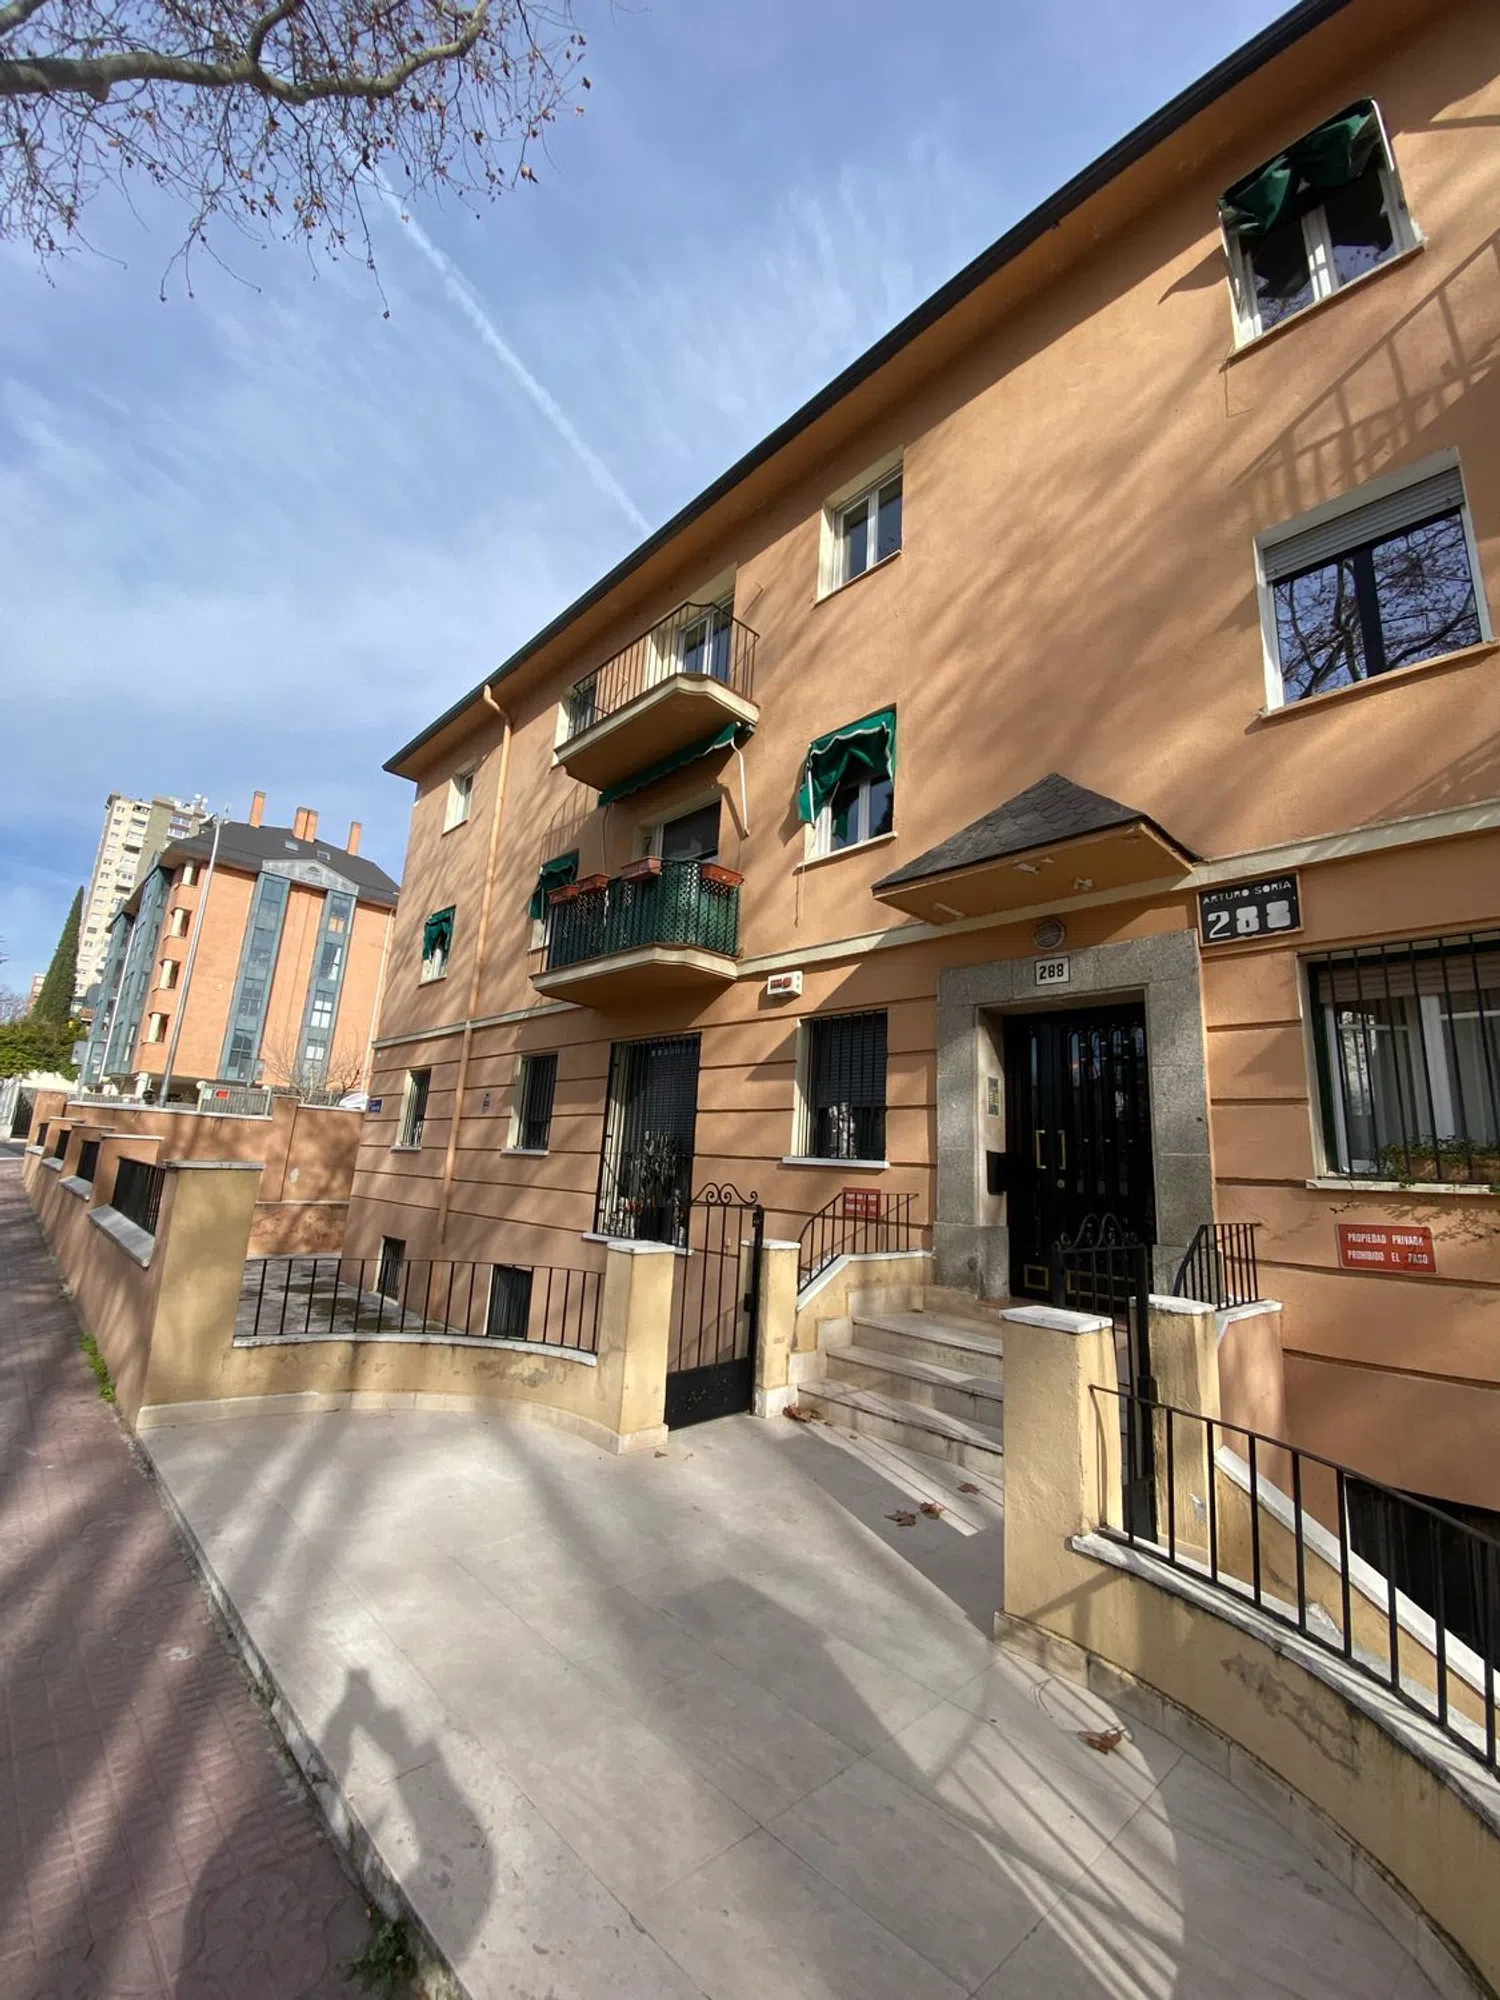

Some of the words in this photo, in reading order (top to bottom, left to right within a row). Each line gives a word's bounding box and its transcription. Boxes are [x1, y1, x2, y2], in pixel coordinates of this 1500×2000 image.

[1202, 889, 1250, 905] ARTURO
[1254, 881, 1292, 894] SORIA
[1208, 900, 1291, 938] 288
[1039, 963, 1064, 980] 288
[1348, 1233, 1387, 1244] PROPIEDAD
[1392, 1234, 1423, 1246] PRIVADA
[1347, 1250, 1384, 1261] PROHIBIDO
[1391, 1252, 1400, 1263] EL
[1408, 1253, 1428, 1264] PASO
